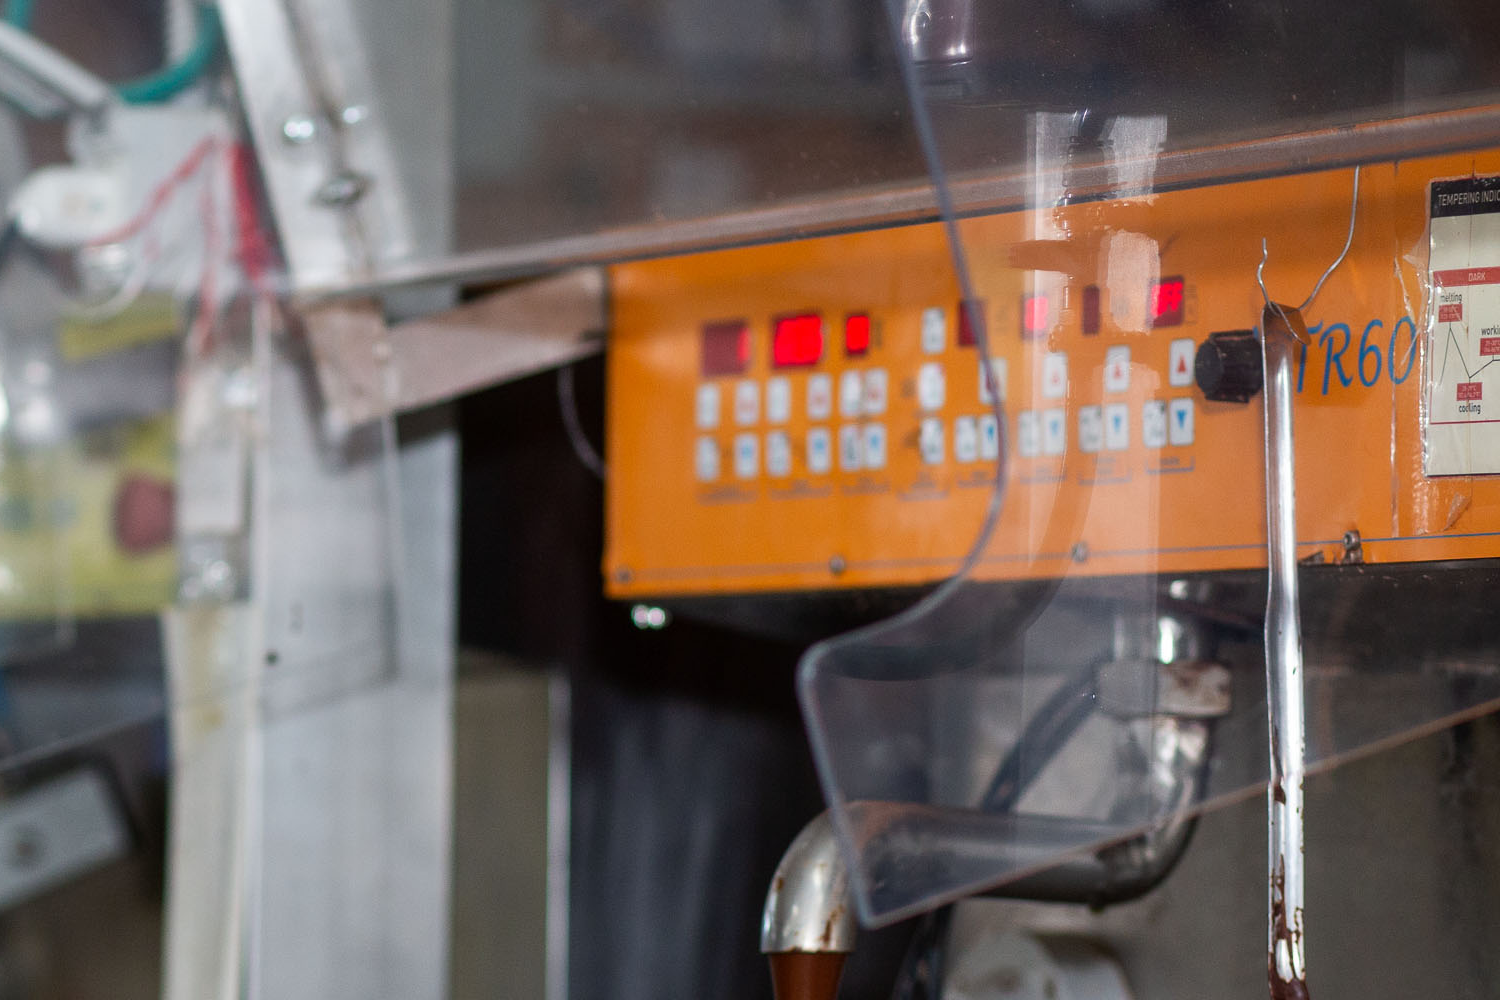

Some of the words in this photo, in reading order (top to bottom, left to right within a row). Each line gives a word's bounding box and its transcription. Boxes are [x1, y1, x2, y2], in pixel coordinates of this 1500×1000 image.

[1438, 191, 1480, 206] TEMPERING
[1468, 272, 1486, 281] DARK
[1440, 292, 1462, 304] melting
